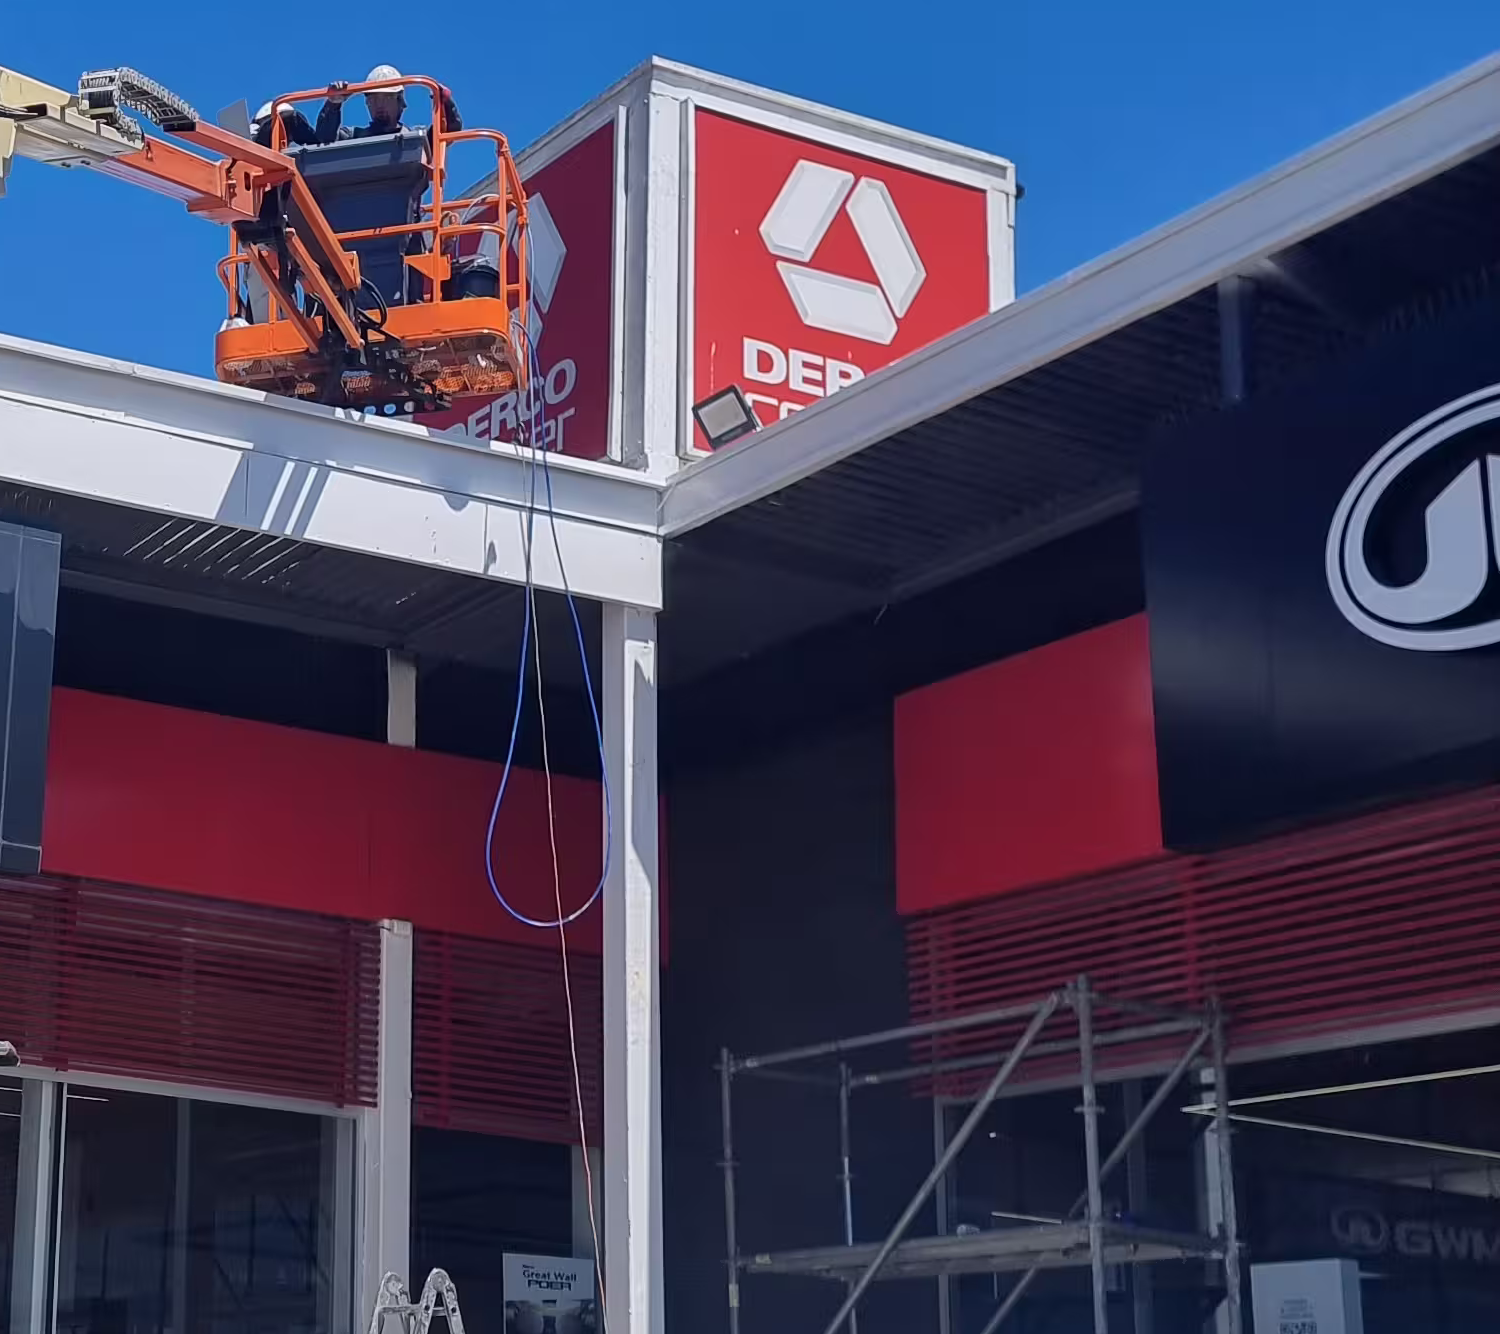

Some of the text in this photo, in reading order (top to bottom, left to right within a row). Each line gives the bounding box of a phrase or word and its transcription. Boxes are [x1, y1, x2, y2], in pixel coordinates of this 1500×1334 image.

[742, 335, 866, 398] DER
[522, 1269, 577, 1282] Great Wall
